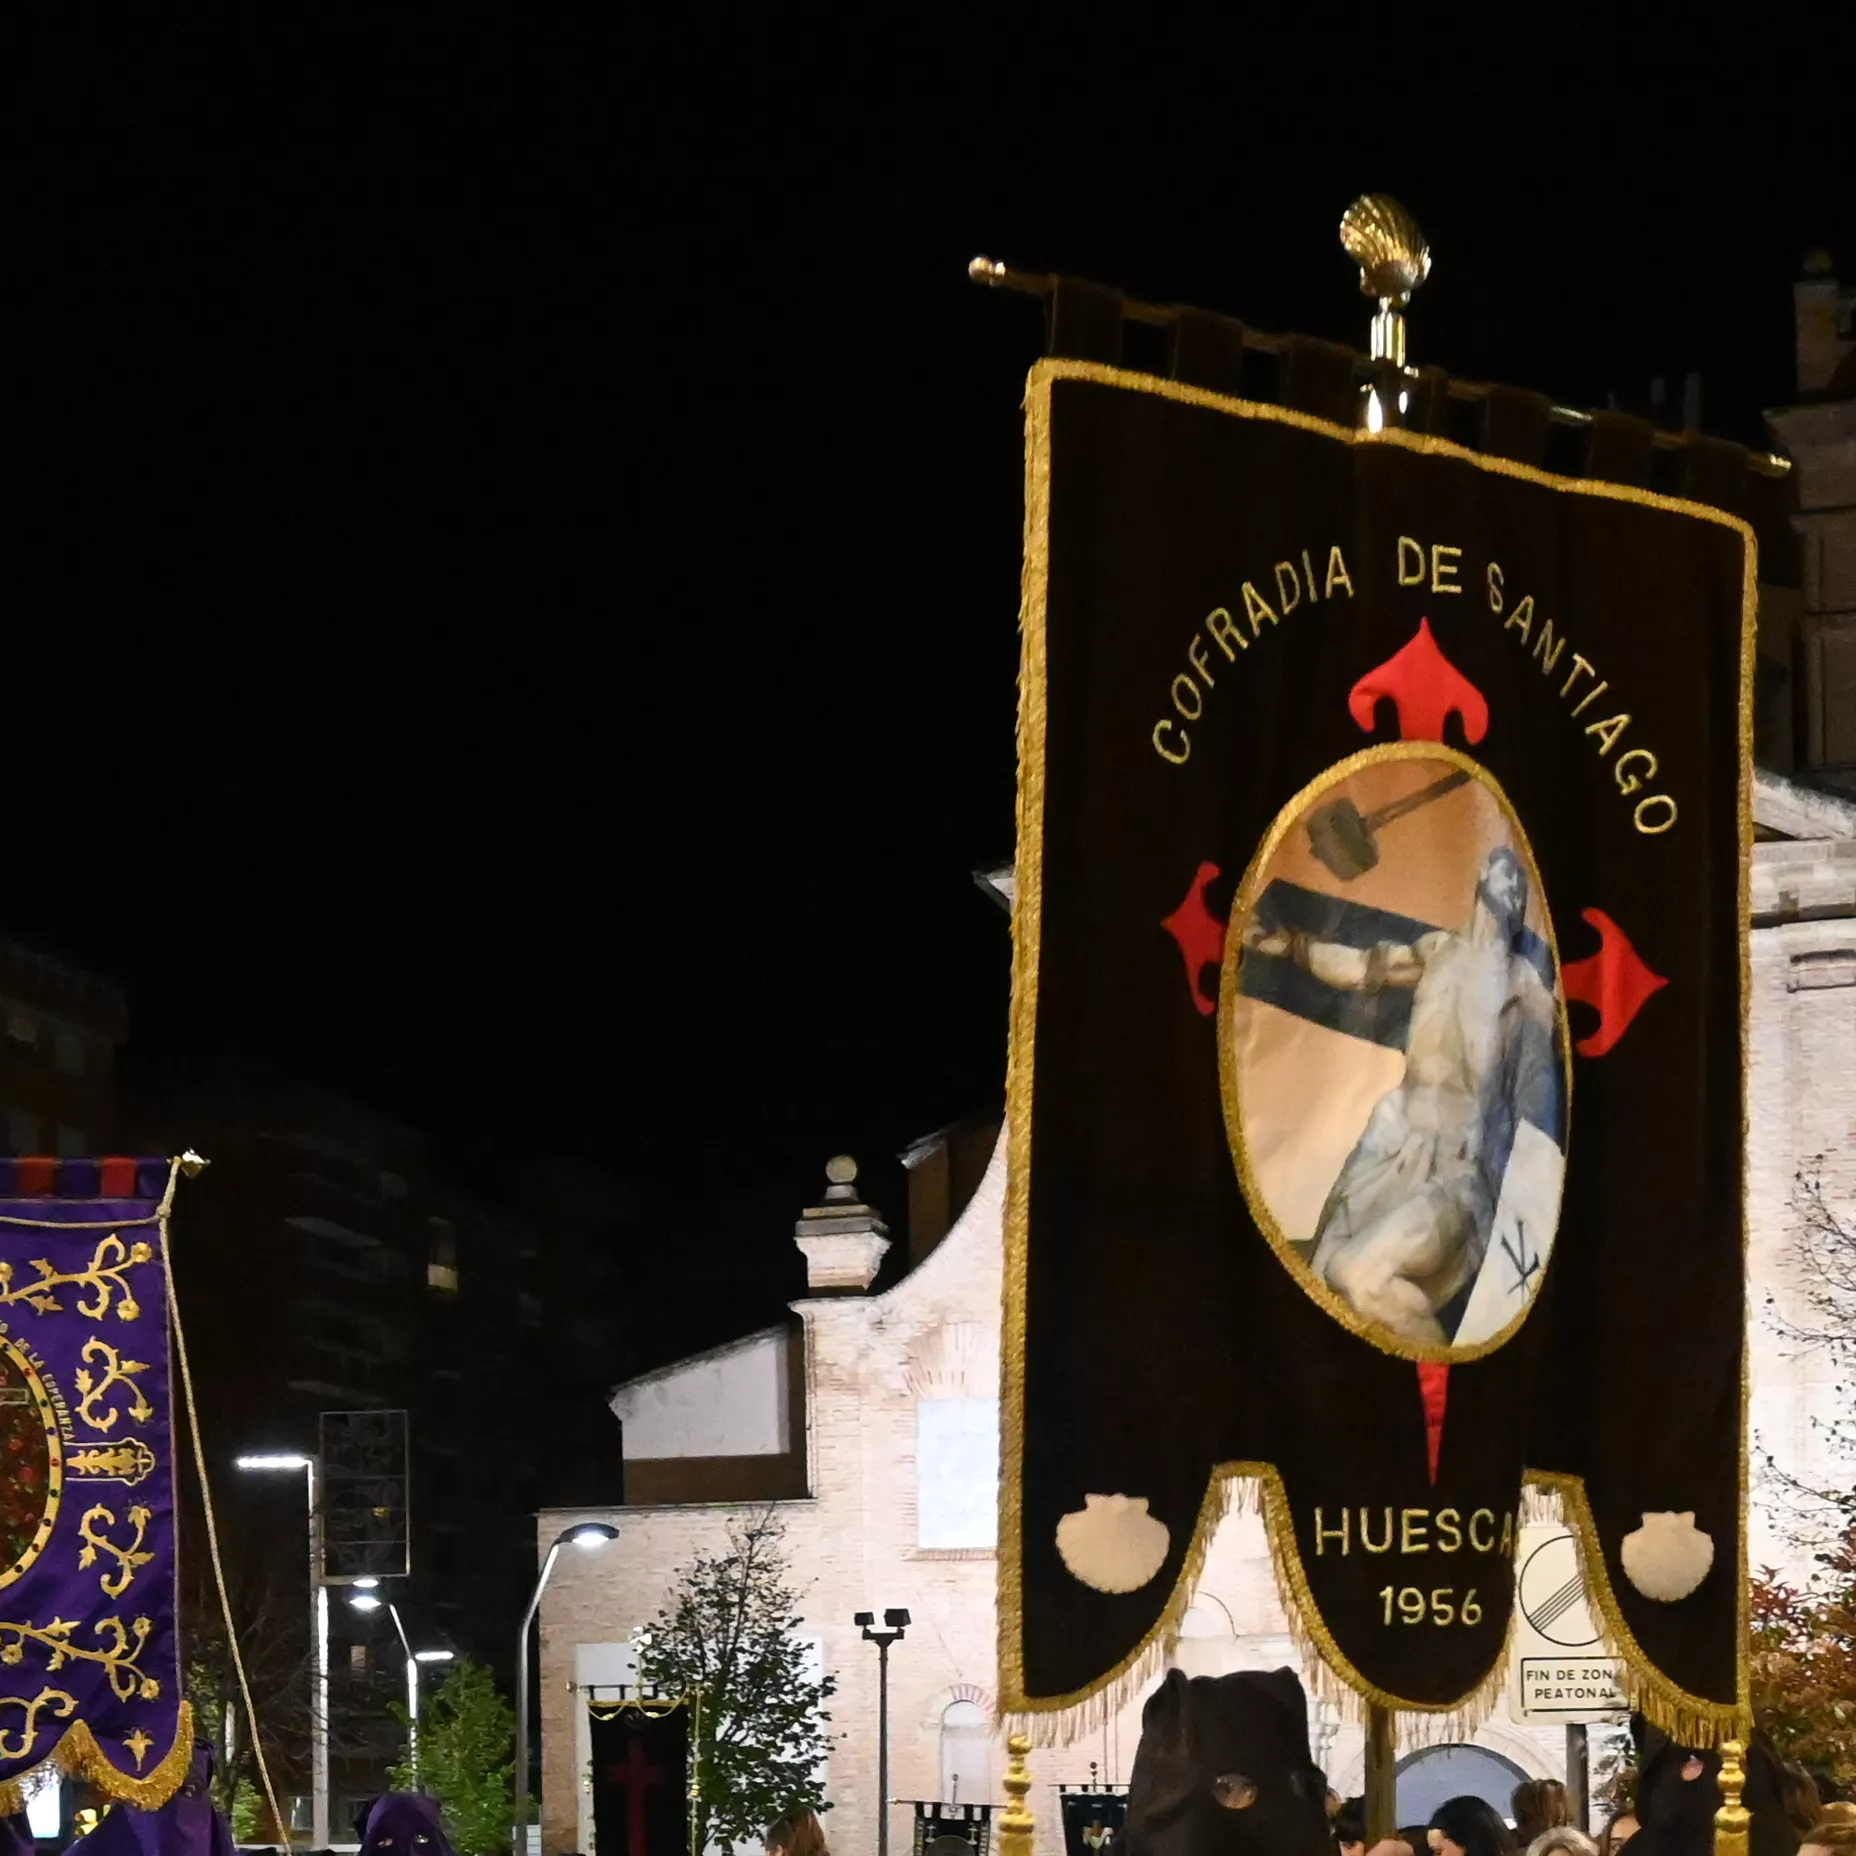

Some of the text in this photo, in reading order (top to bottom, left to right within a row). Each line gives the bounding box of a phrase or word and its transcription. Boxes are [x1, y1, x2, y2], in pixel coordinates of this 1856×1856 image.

[1151, 535, 1679, 835] COFRADIA DE SANTIAGO
[29, 1352, 46, 1370] LA
[42, 1373, 76, 1441] ESPERANZA
[1314, 1505, 1513, 1557] HUESCA
[1378, 1585, 1483, 1627] 1956
[1526, 1668, 1613, 1681] FIN DE ZON
[1534, 1687, 1617, 1700] PEATONAL
